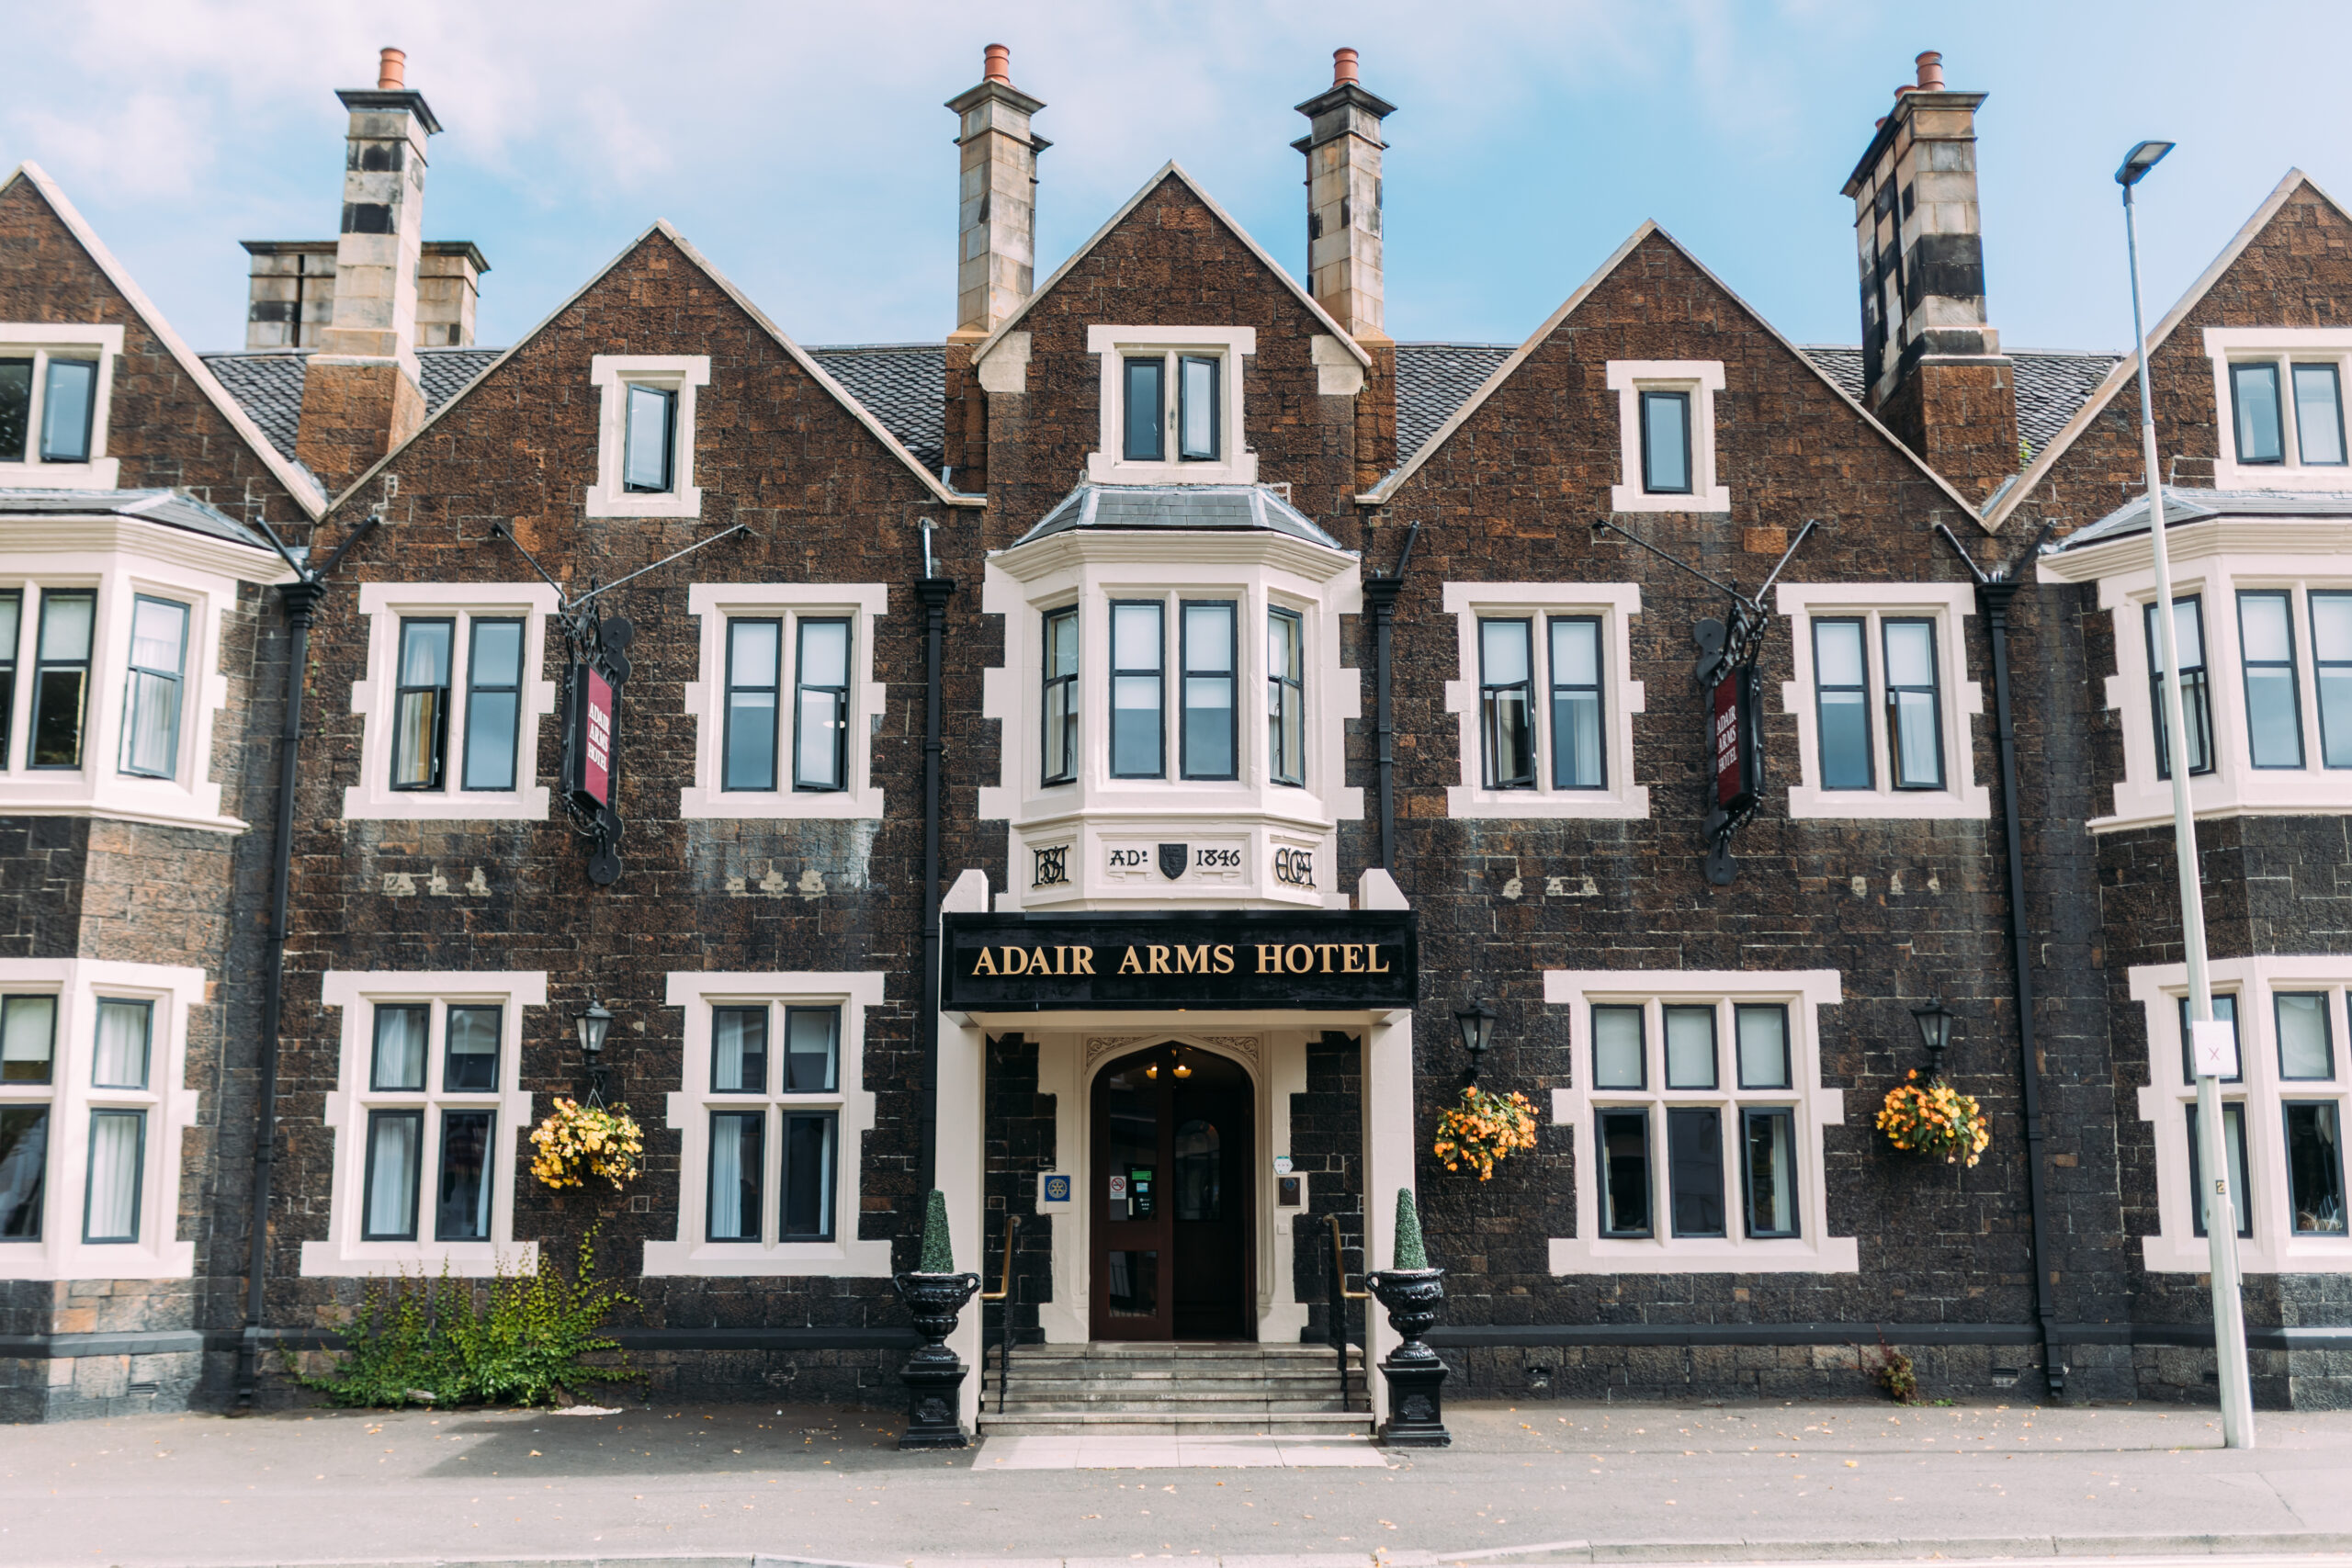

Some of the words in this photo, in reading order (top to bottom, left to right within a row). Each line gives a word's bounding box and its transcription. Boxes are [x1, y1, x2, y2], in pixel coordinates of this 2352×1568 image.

[589, 702, 610, 736] ADAIR
[1716, 705, 1737, 736] ADAIR
[589, 723, 608, 752] ARMS
[1718, 725, 1736, 754] ARMS
[588, 741, 608, 773] HOTEL
[1718, 746, 1737, 773] HOTEL
[1195, 849, 1241, 866] 1846
[972, 945, 1096, 976] ADAIR
[1117, 944, 1235, 975] ARMS
[1254, 943, 1390, 974] HOTEL
[2216, 1181, 2226, 1193] 2
